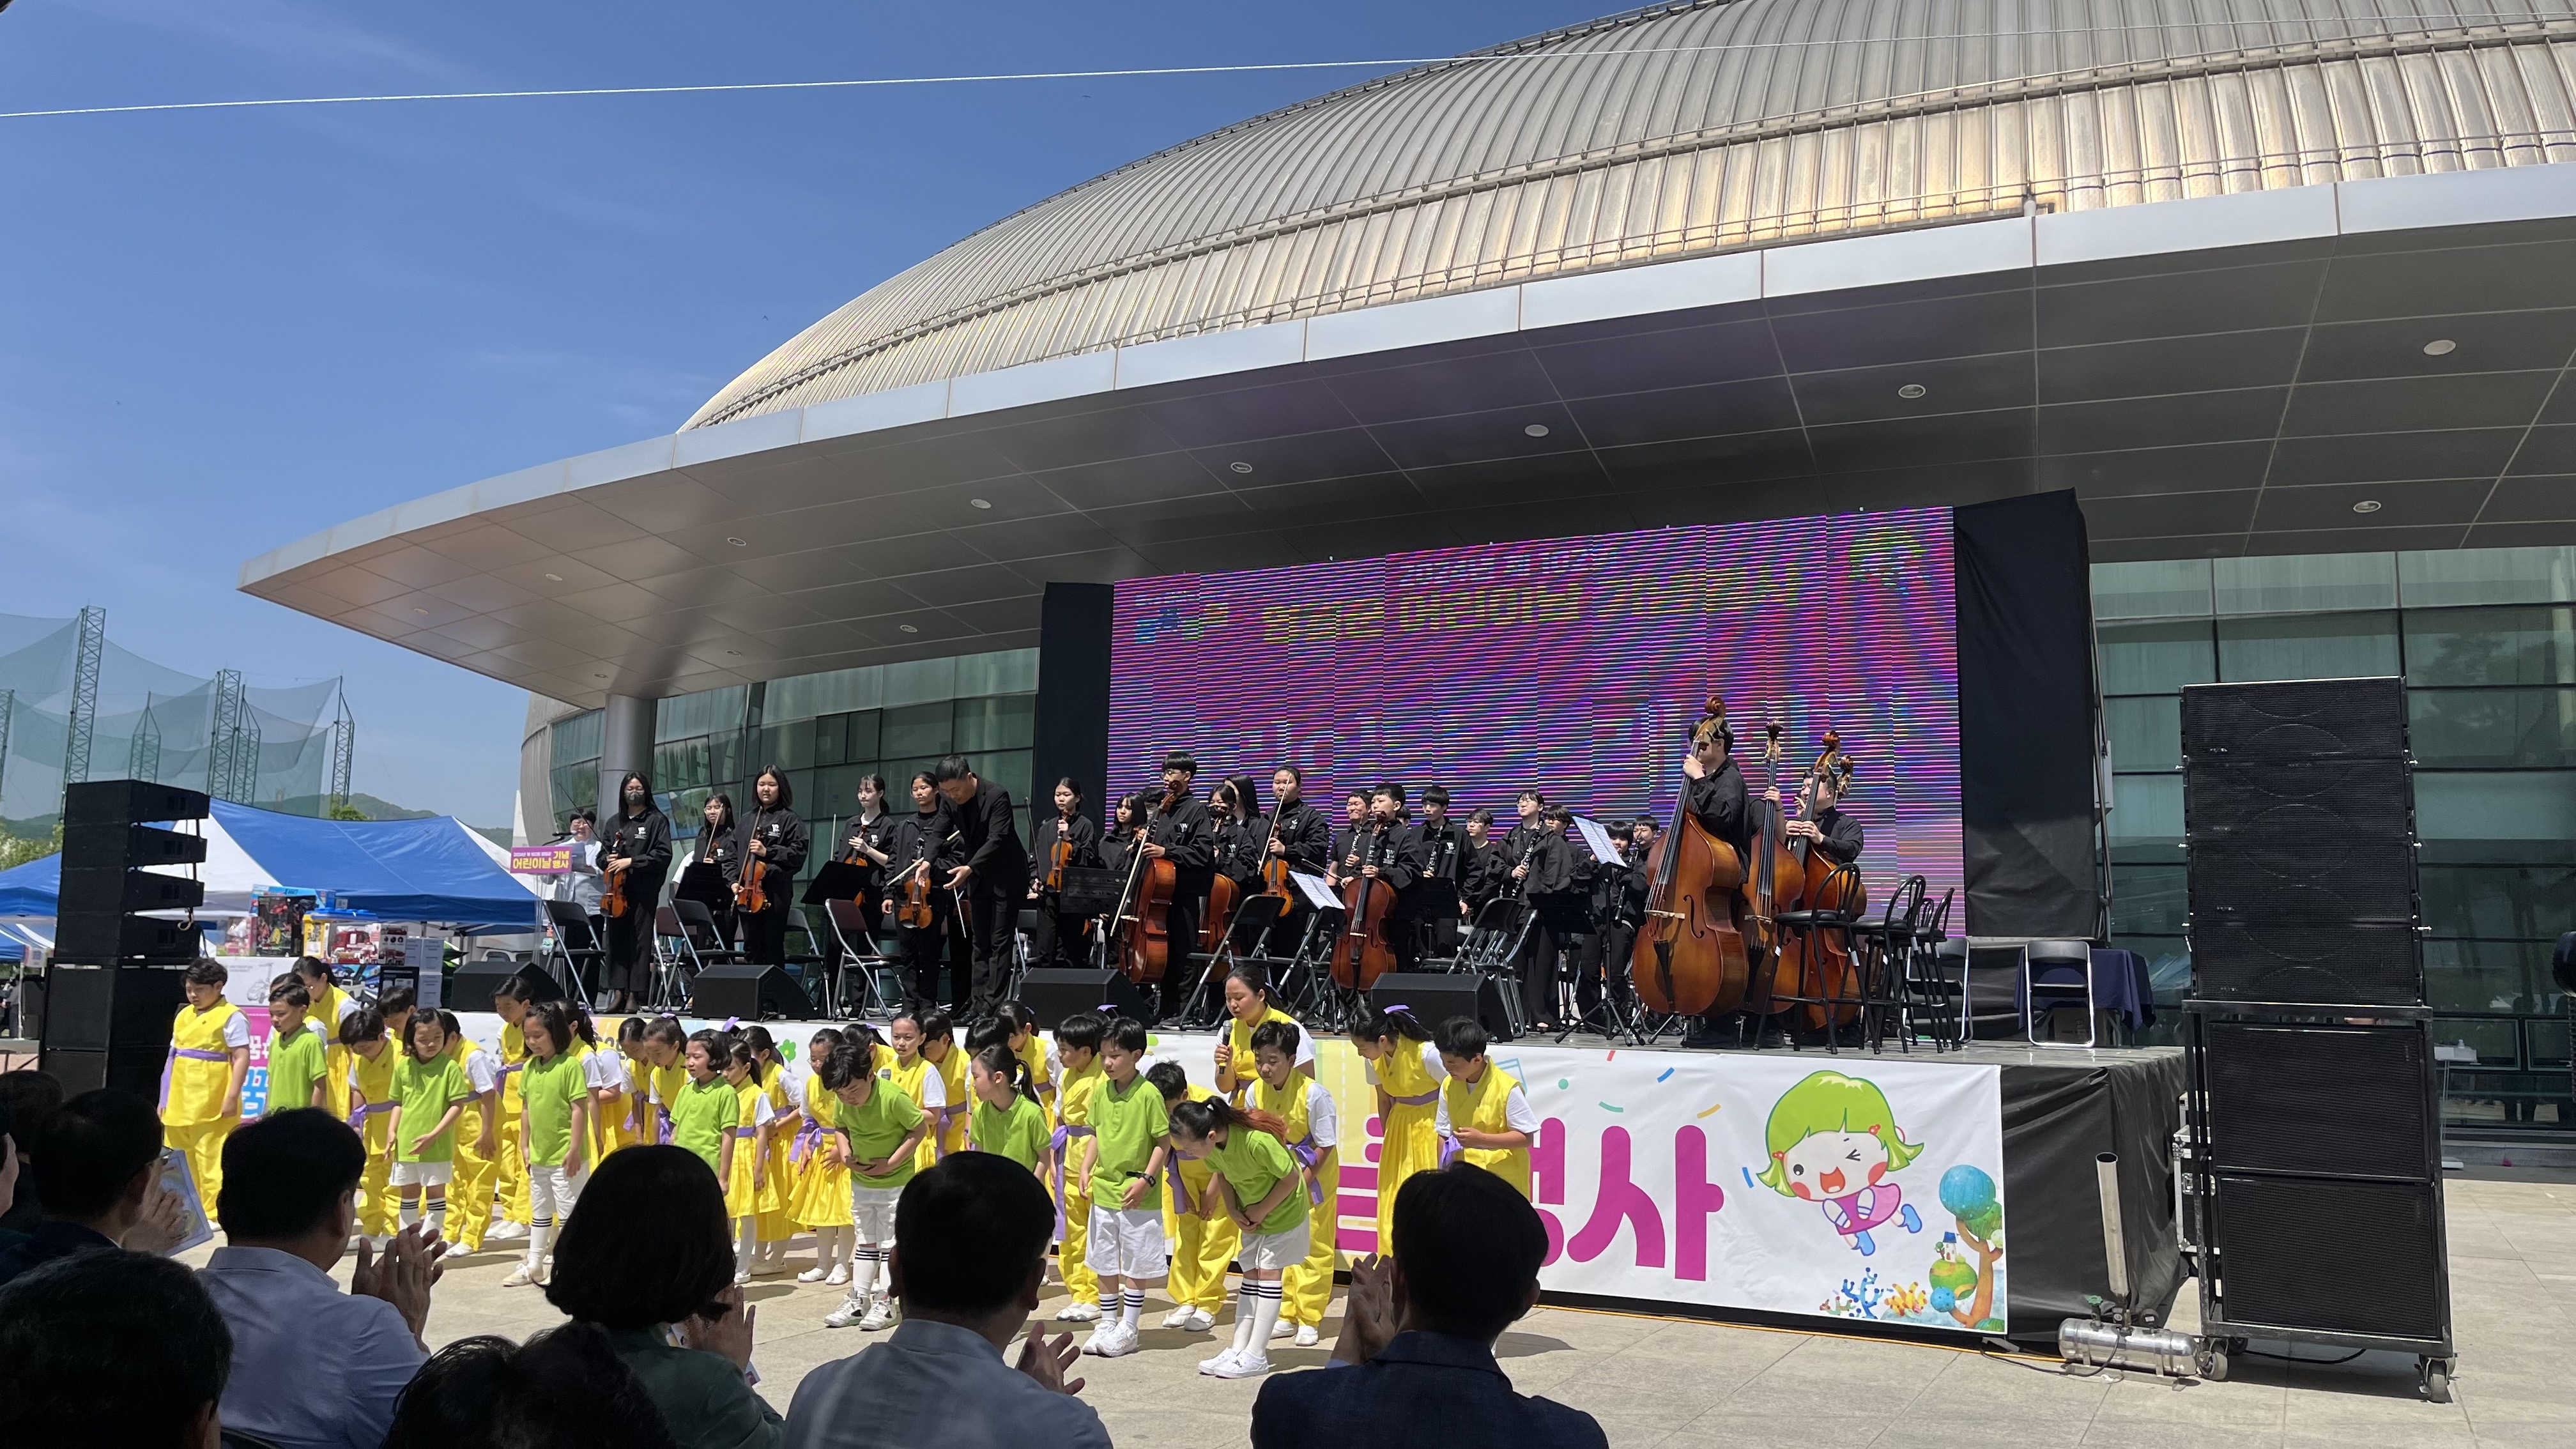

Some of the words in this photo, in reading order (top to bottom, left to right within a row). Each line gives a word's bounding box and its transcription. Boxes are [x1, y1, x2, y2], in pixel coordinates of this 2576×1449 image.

[1399, 581, 1583, 633] 어린이날
[512, 857, 552, 869] 어린이날
[553, 850, 569, 859] 기념
